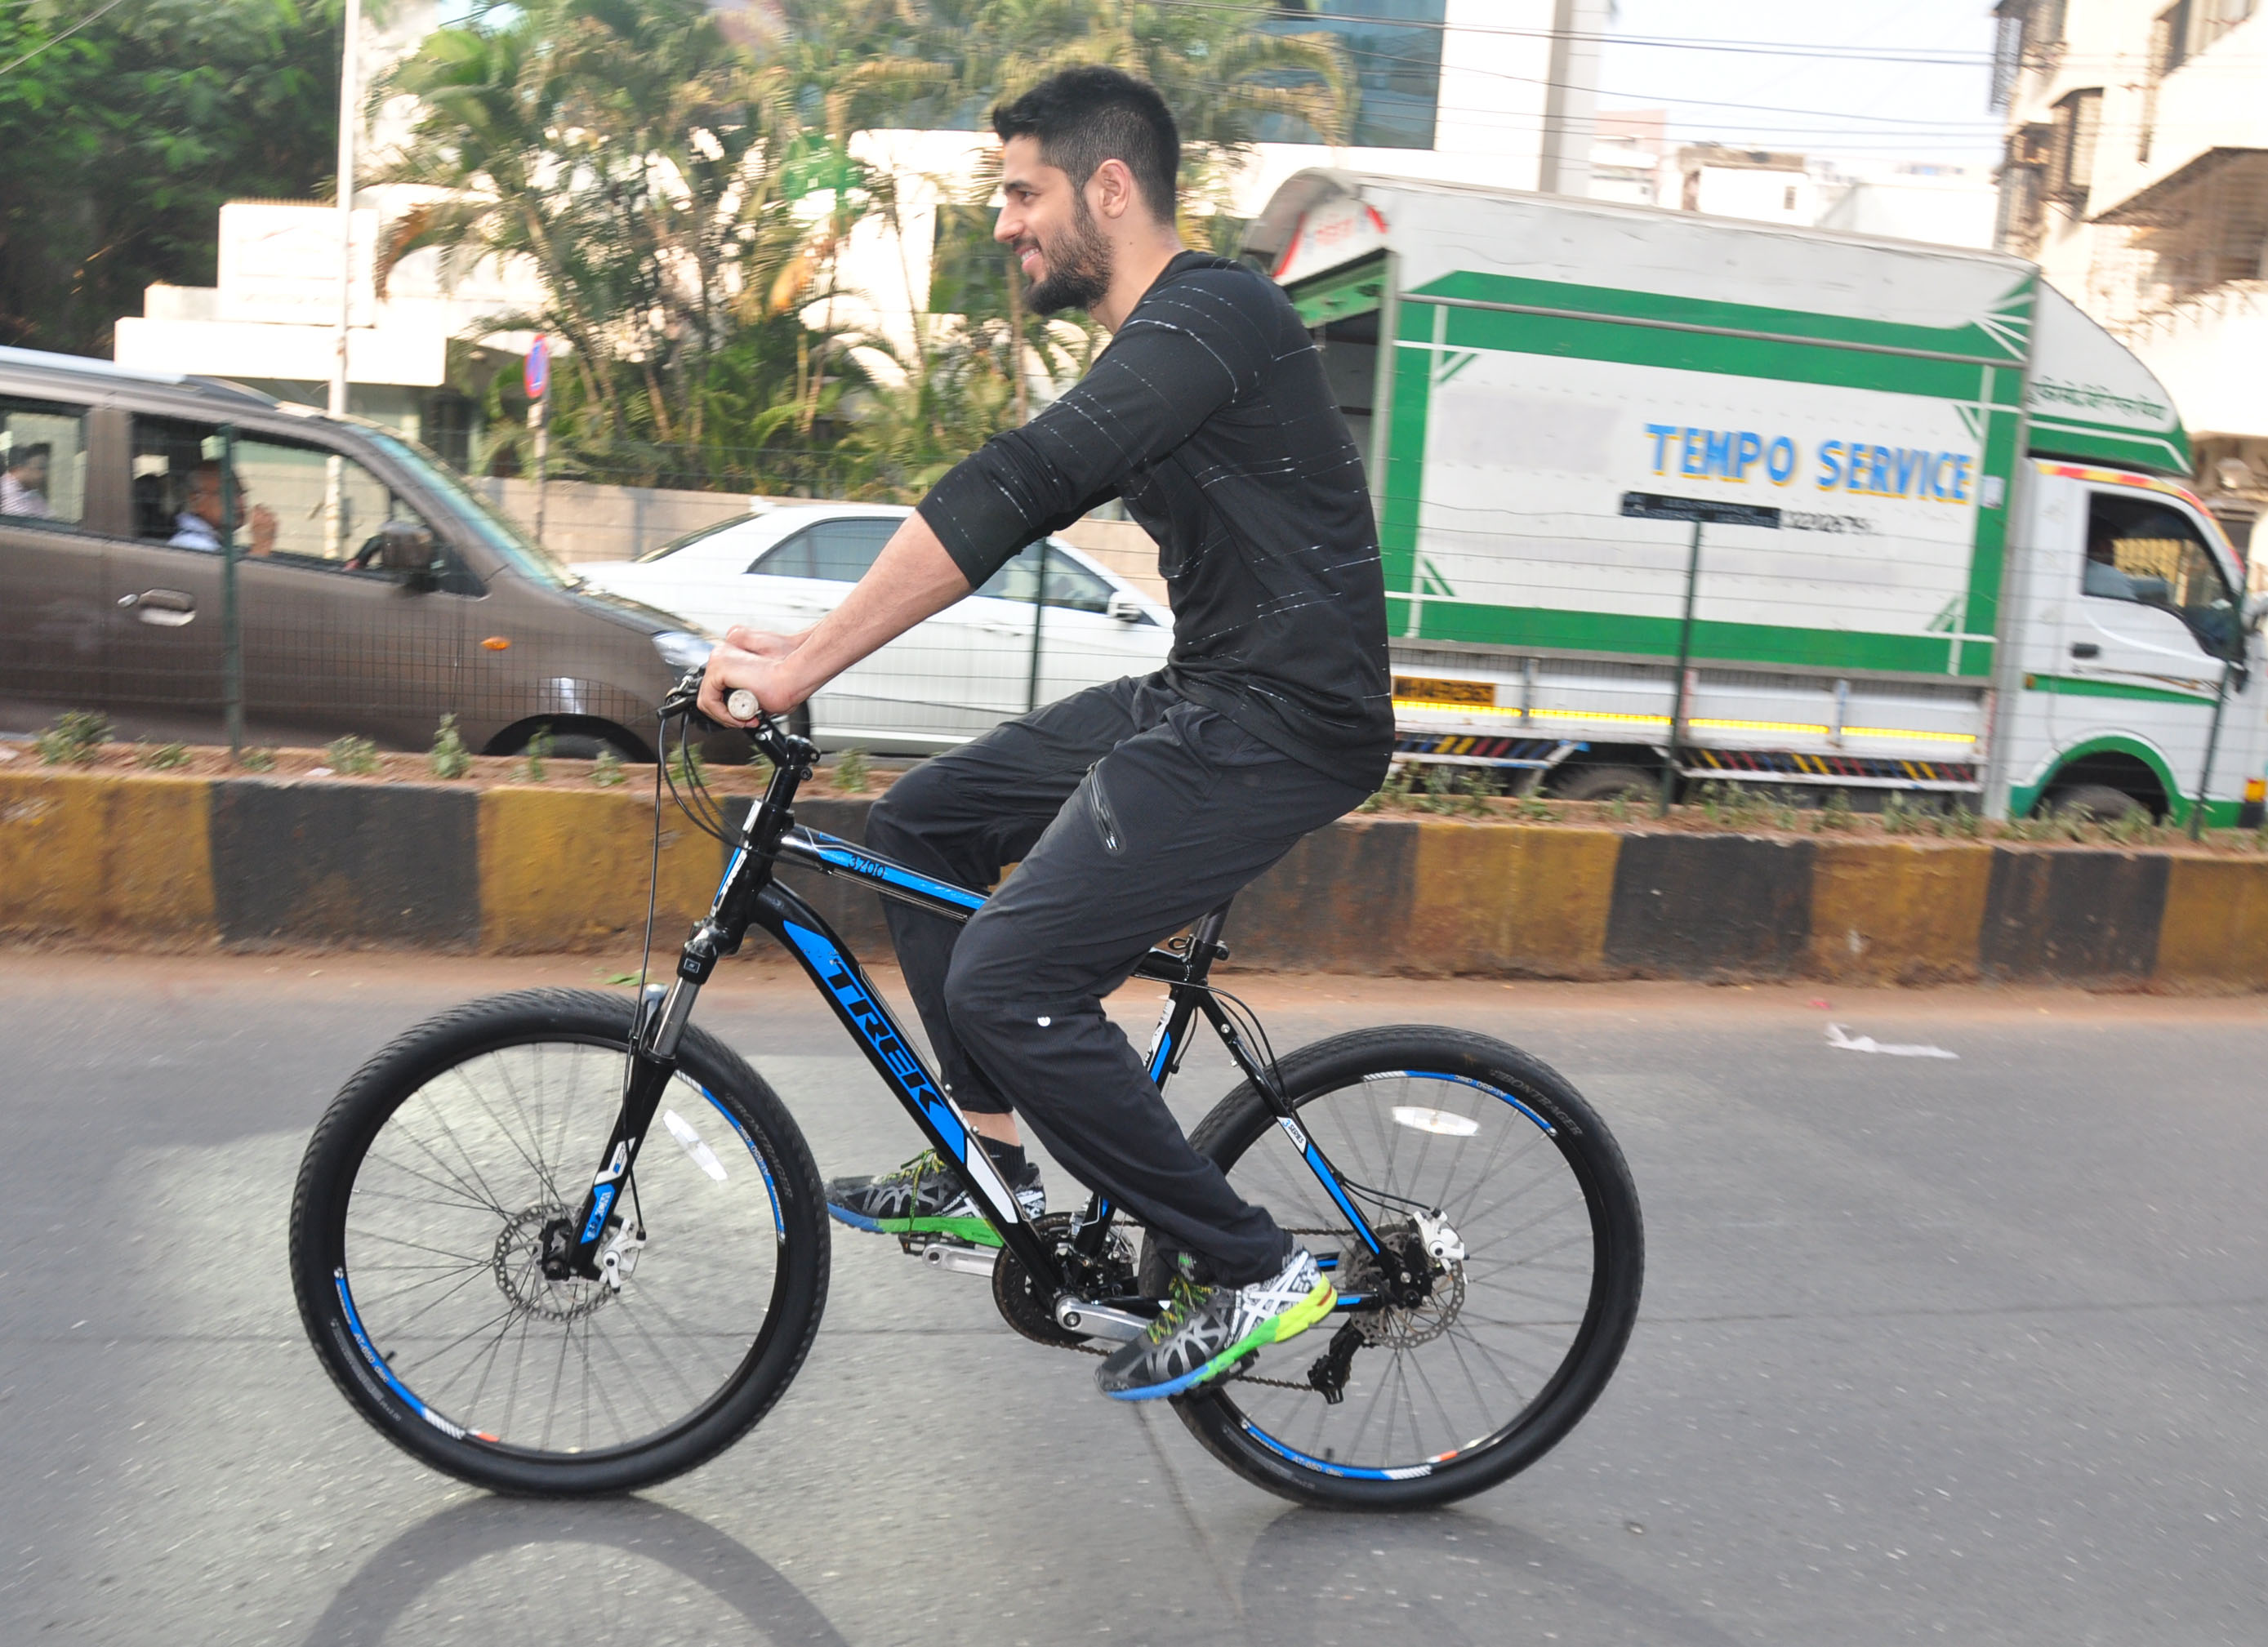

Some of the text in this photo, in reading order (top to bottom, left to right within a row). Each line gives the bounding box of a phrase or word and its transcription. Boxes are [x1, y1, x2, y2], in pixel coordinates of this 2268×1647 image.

[1644, 422, 1973, 505] TEMPO SERVICE
[848, 854, 885, 880] 3700
[827, 958, 946, 1115] TREK
[1281, 1119, 1305, 1144] 3 SERIES
